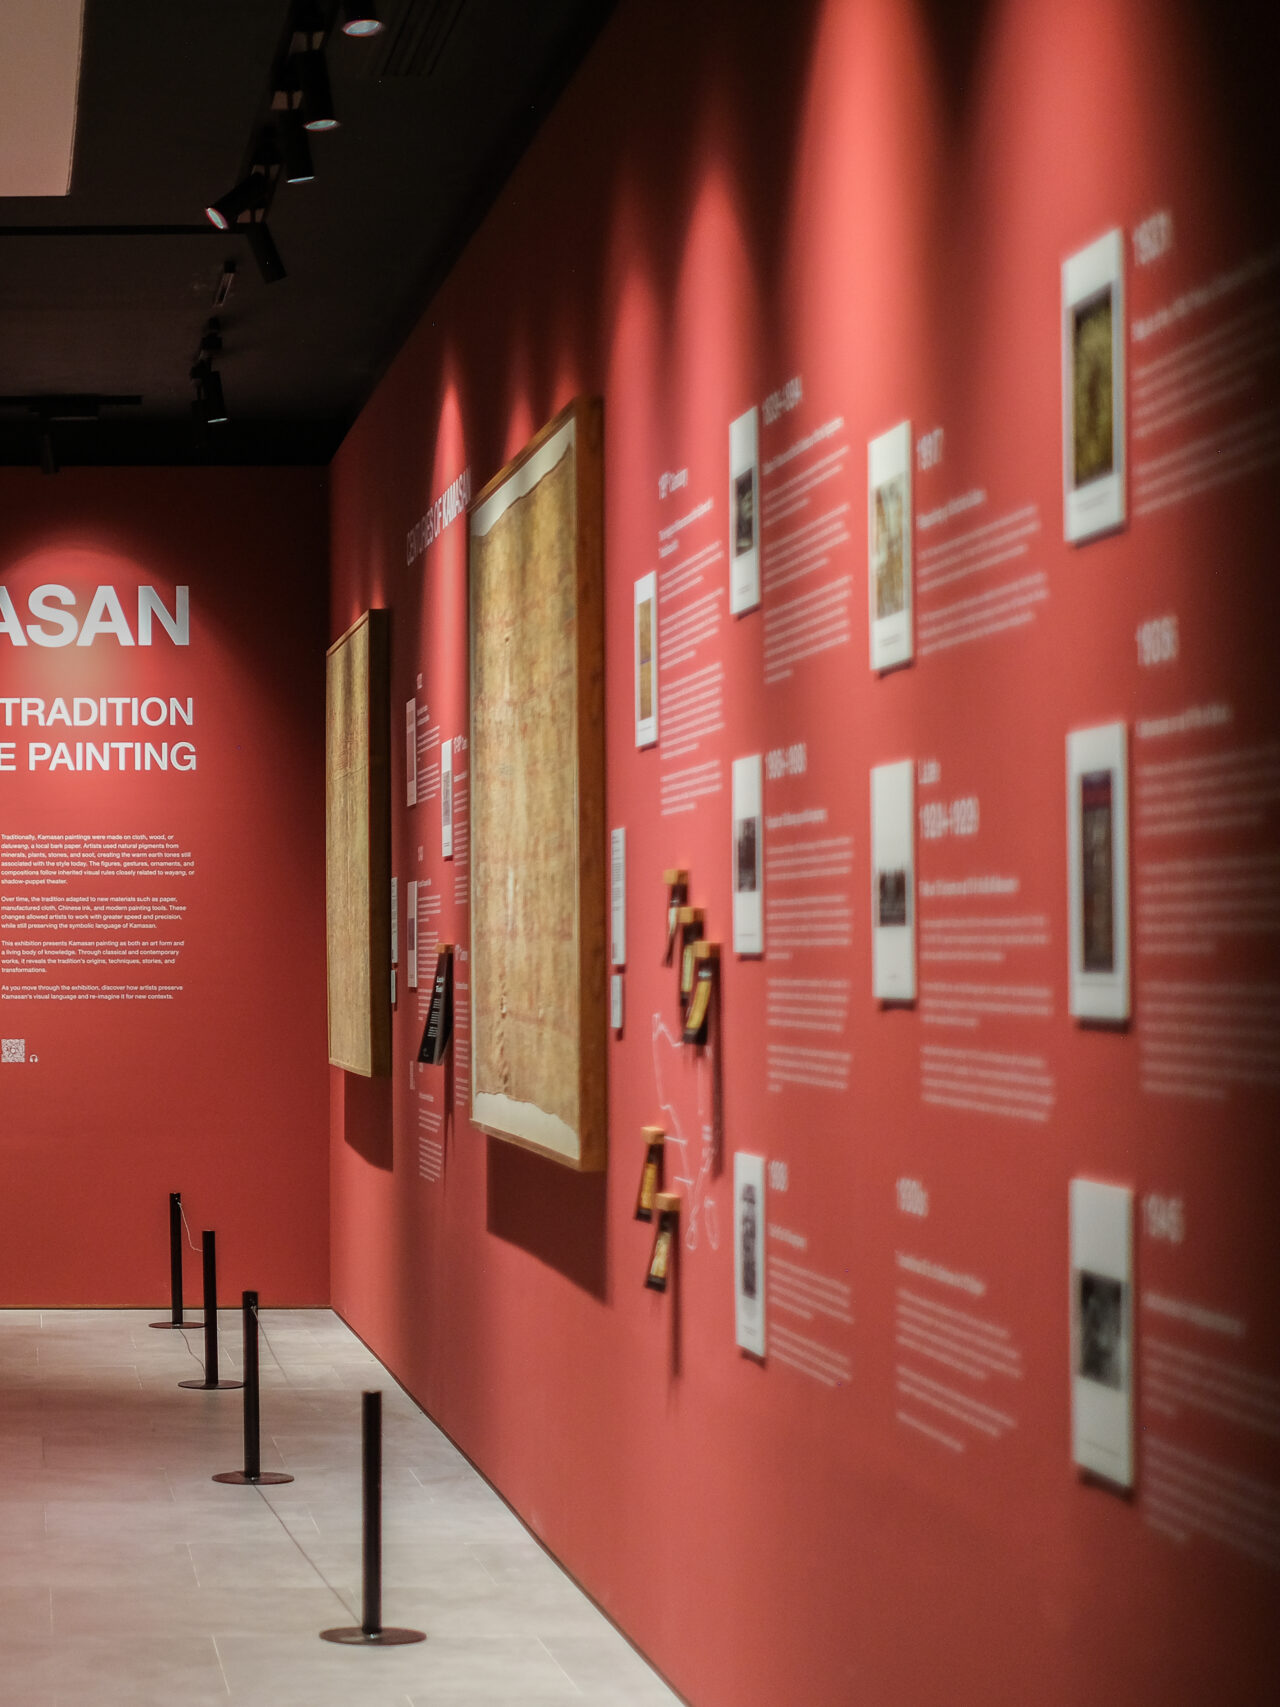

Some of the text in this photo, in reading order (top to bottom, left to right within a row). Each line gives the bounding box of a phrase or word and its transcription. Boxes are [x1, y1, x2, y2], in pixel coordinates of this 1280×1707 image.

[434, 497, 442, 538] OF
[442, 466, 471, 530] KAMASAN
[29, 742, 197, 771] PAINTING
[56, 860, 70, 868] style
[69, 922, 94, 930] symbolic
[95, 922, 121, 930] language
[42, 939, 67, 947] presents
[38, 984, 60, 992] through
